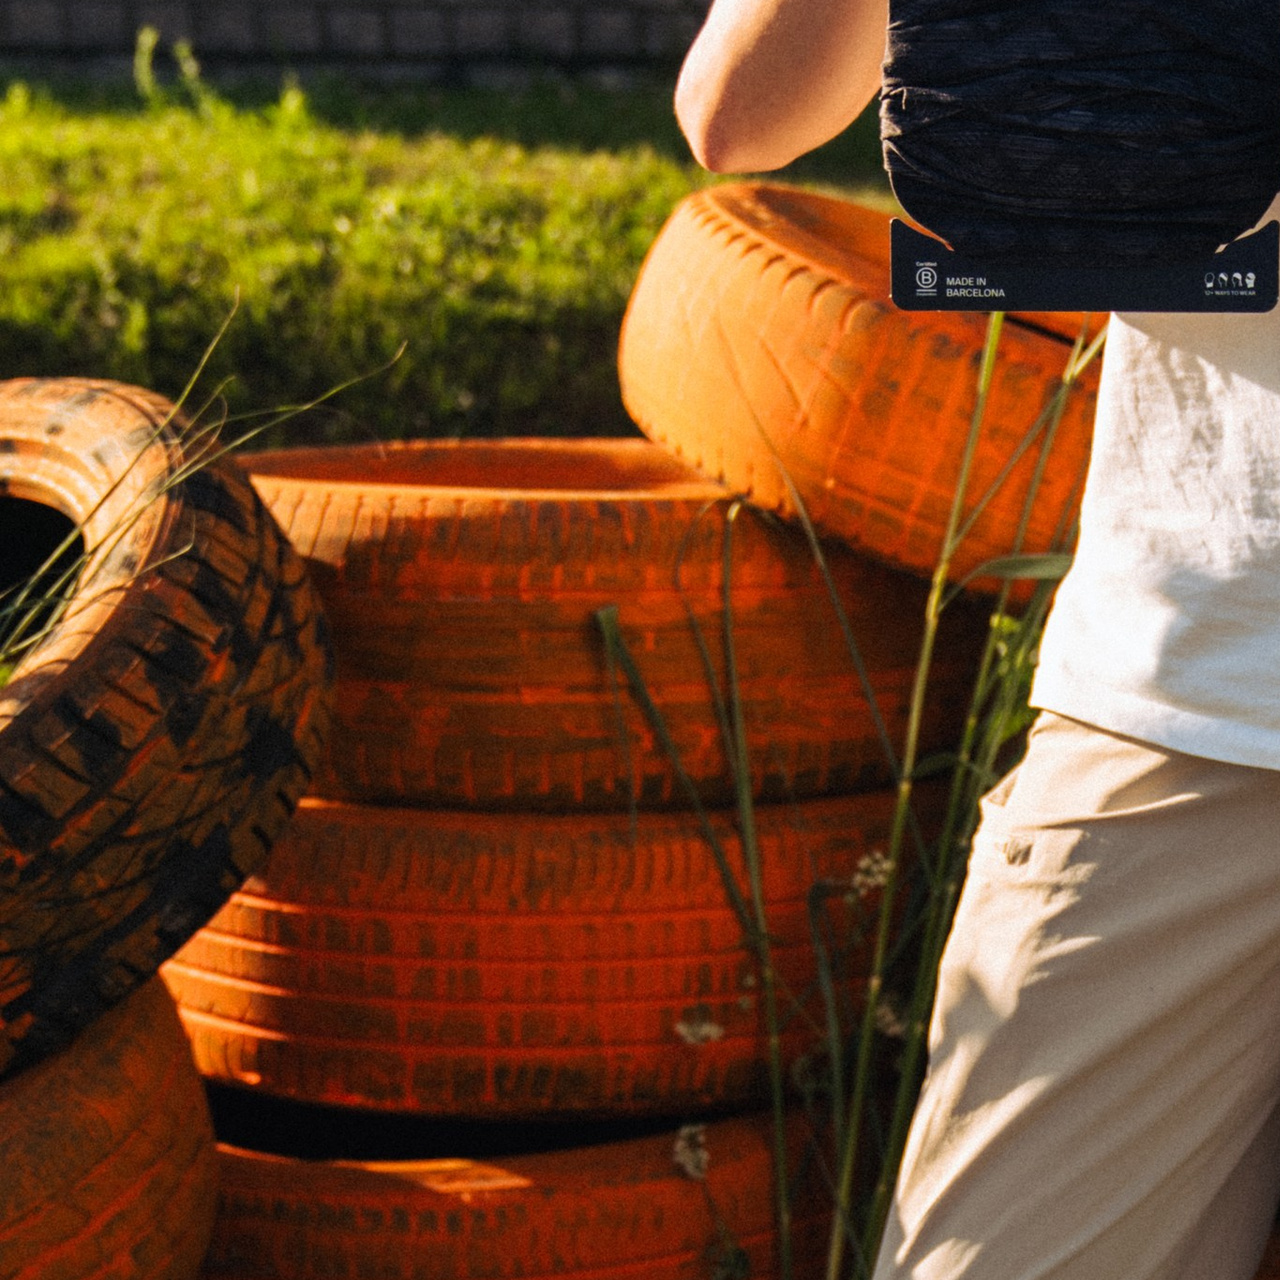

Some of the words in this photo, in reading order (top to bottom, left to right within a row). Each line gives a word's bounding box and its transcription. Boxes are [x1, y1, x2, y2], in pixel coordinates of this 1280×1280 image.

[946, 277, 974, 286] MADE
[976, 277, 986, 286] IN
[946, 288, 1005, 298] BARCELONA
